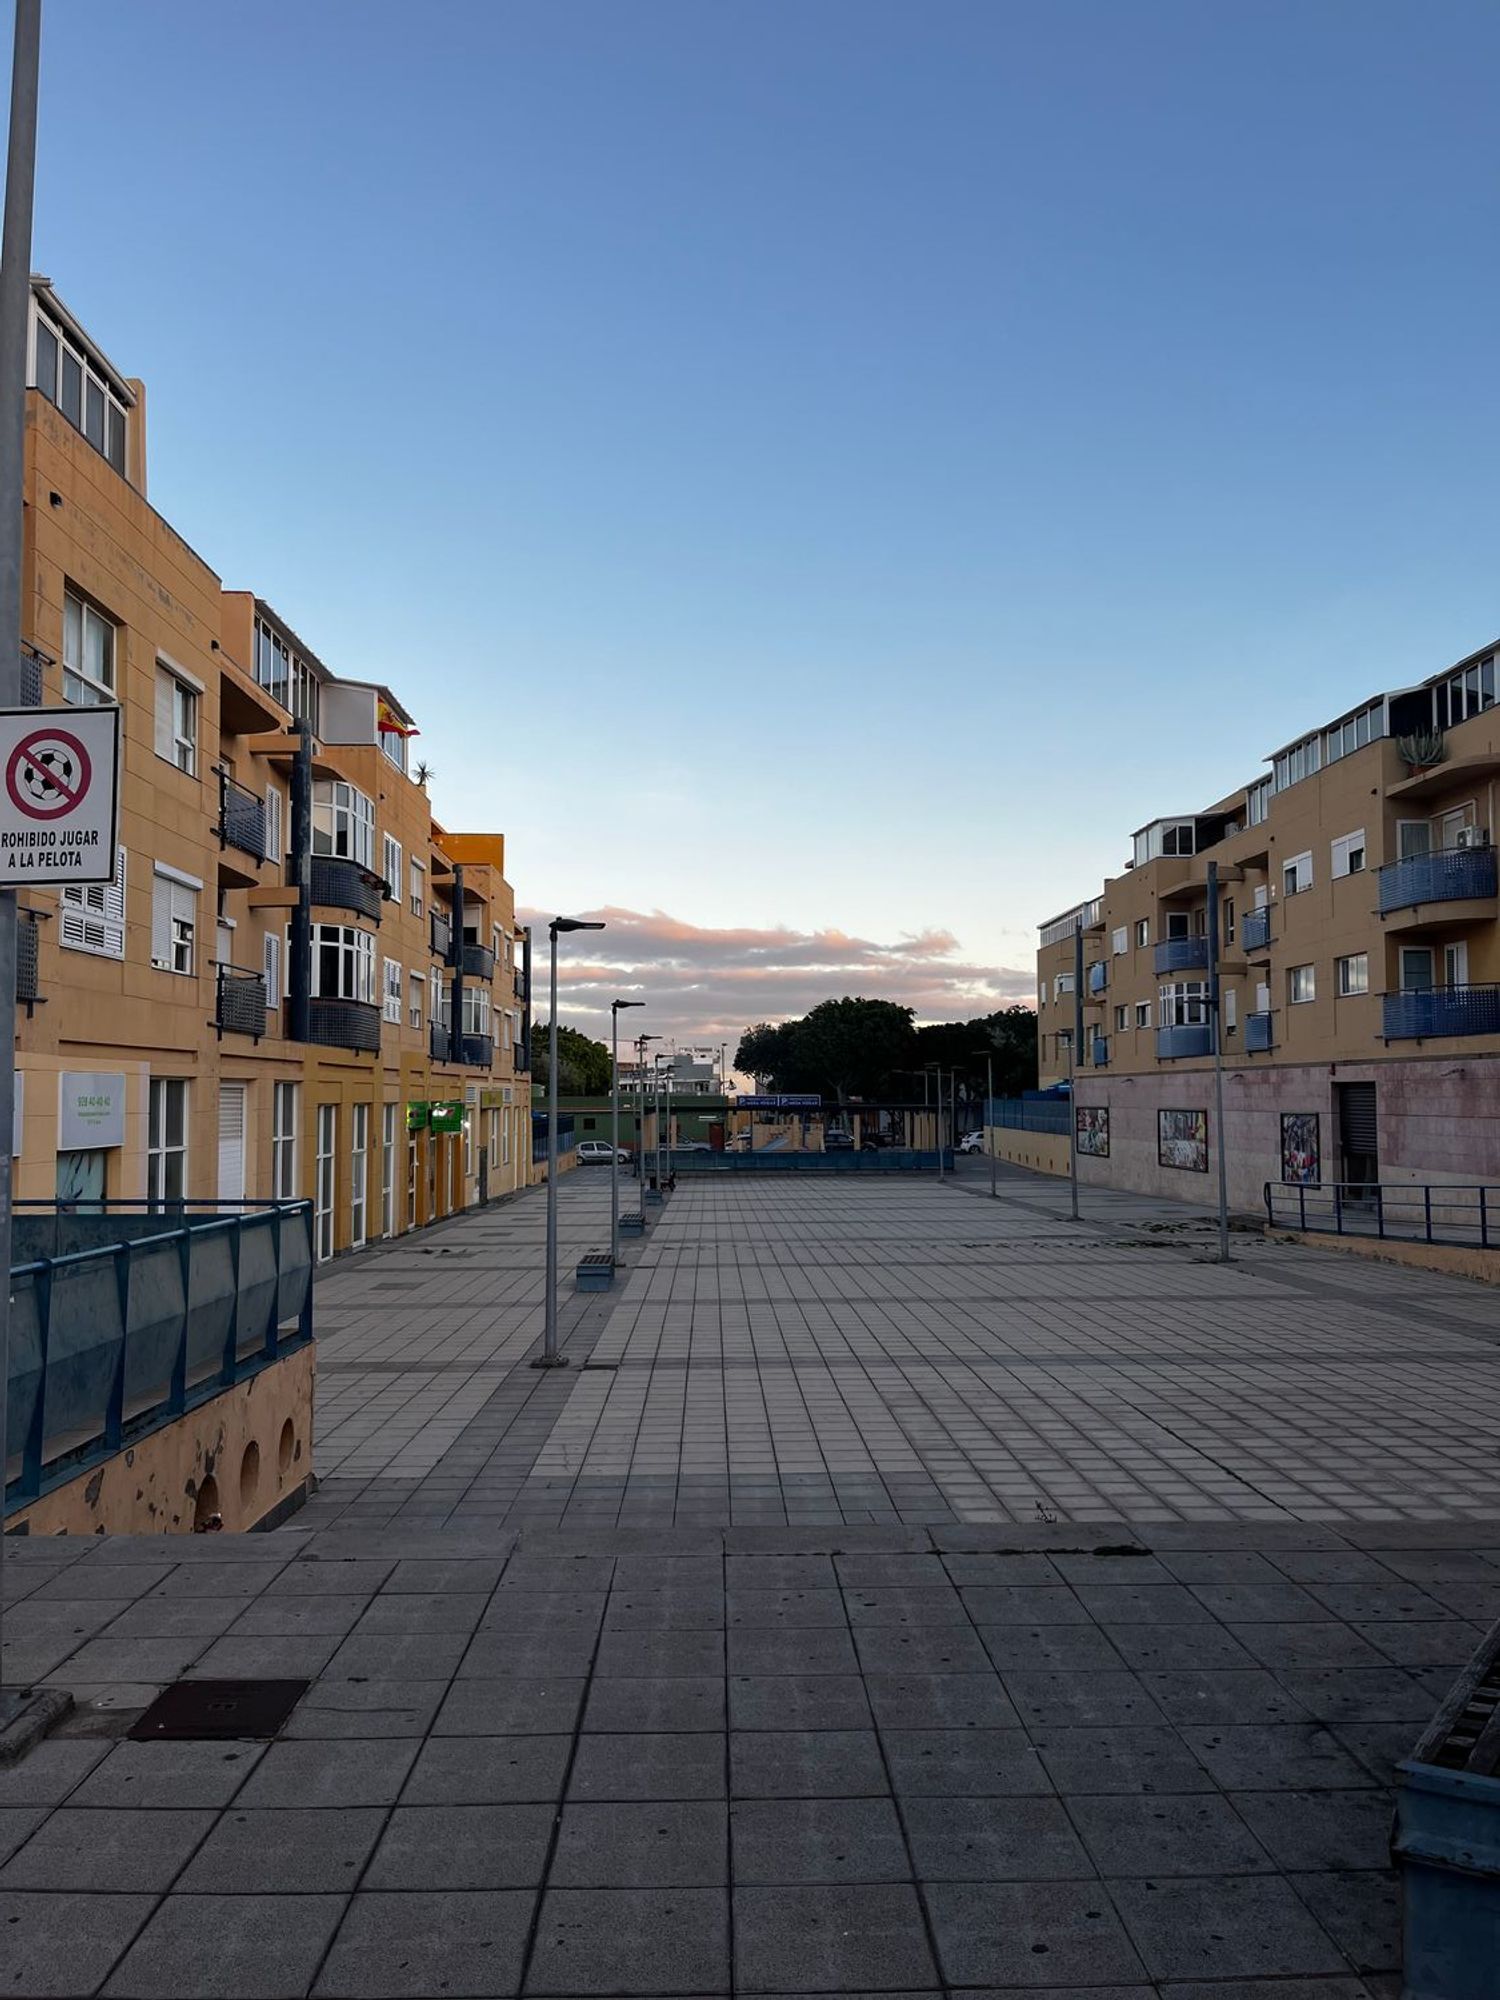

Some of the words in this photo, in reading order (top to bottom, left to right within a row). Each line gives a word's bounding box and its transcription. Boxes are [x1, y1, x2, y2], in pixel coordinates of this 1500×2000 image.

[0, 831, 57, 848] ROHIBIDO
[60, 830, 99, 846] JUGAR
[8, 853, 16, 868] A
[20, 852, 34, 868] LA
[38, 851, 82, 867] PELOTA
